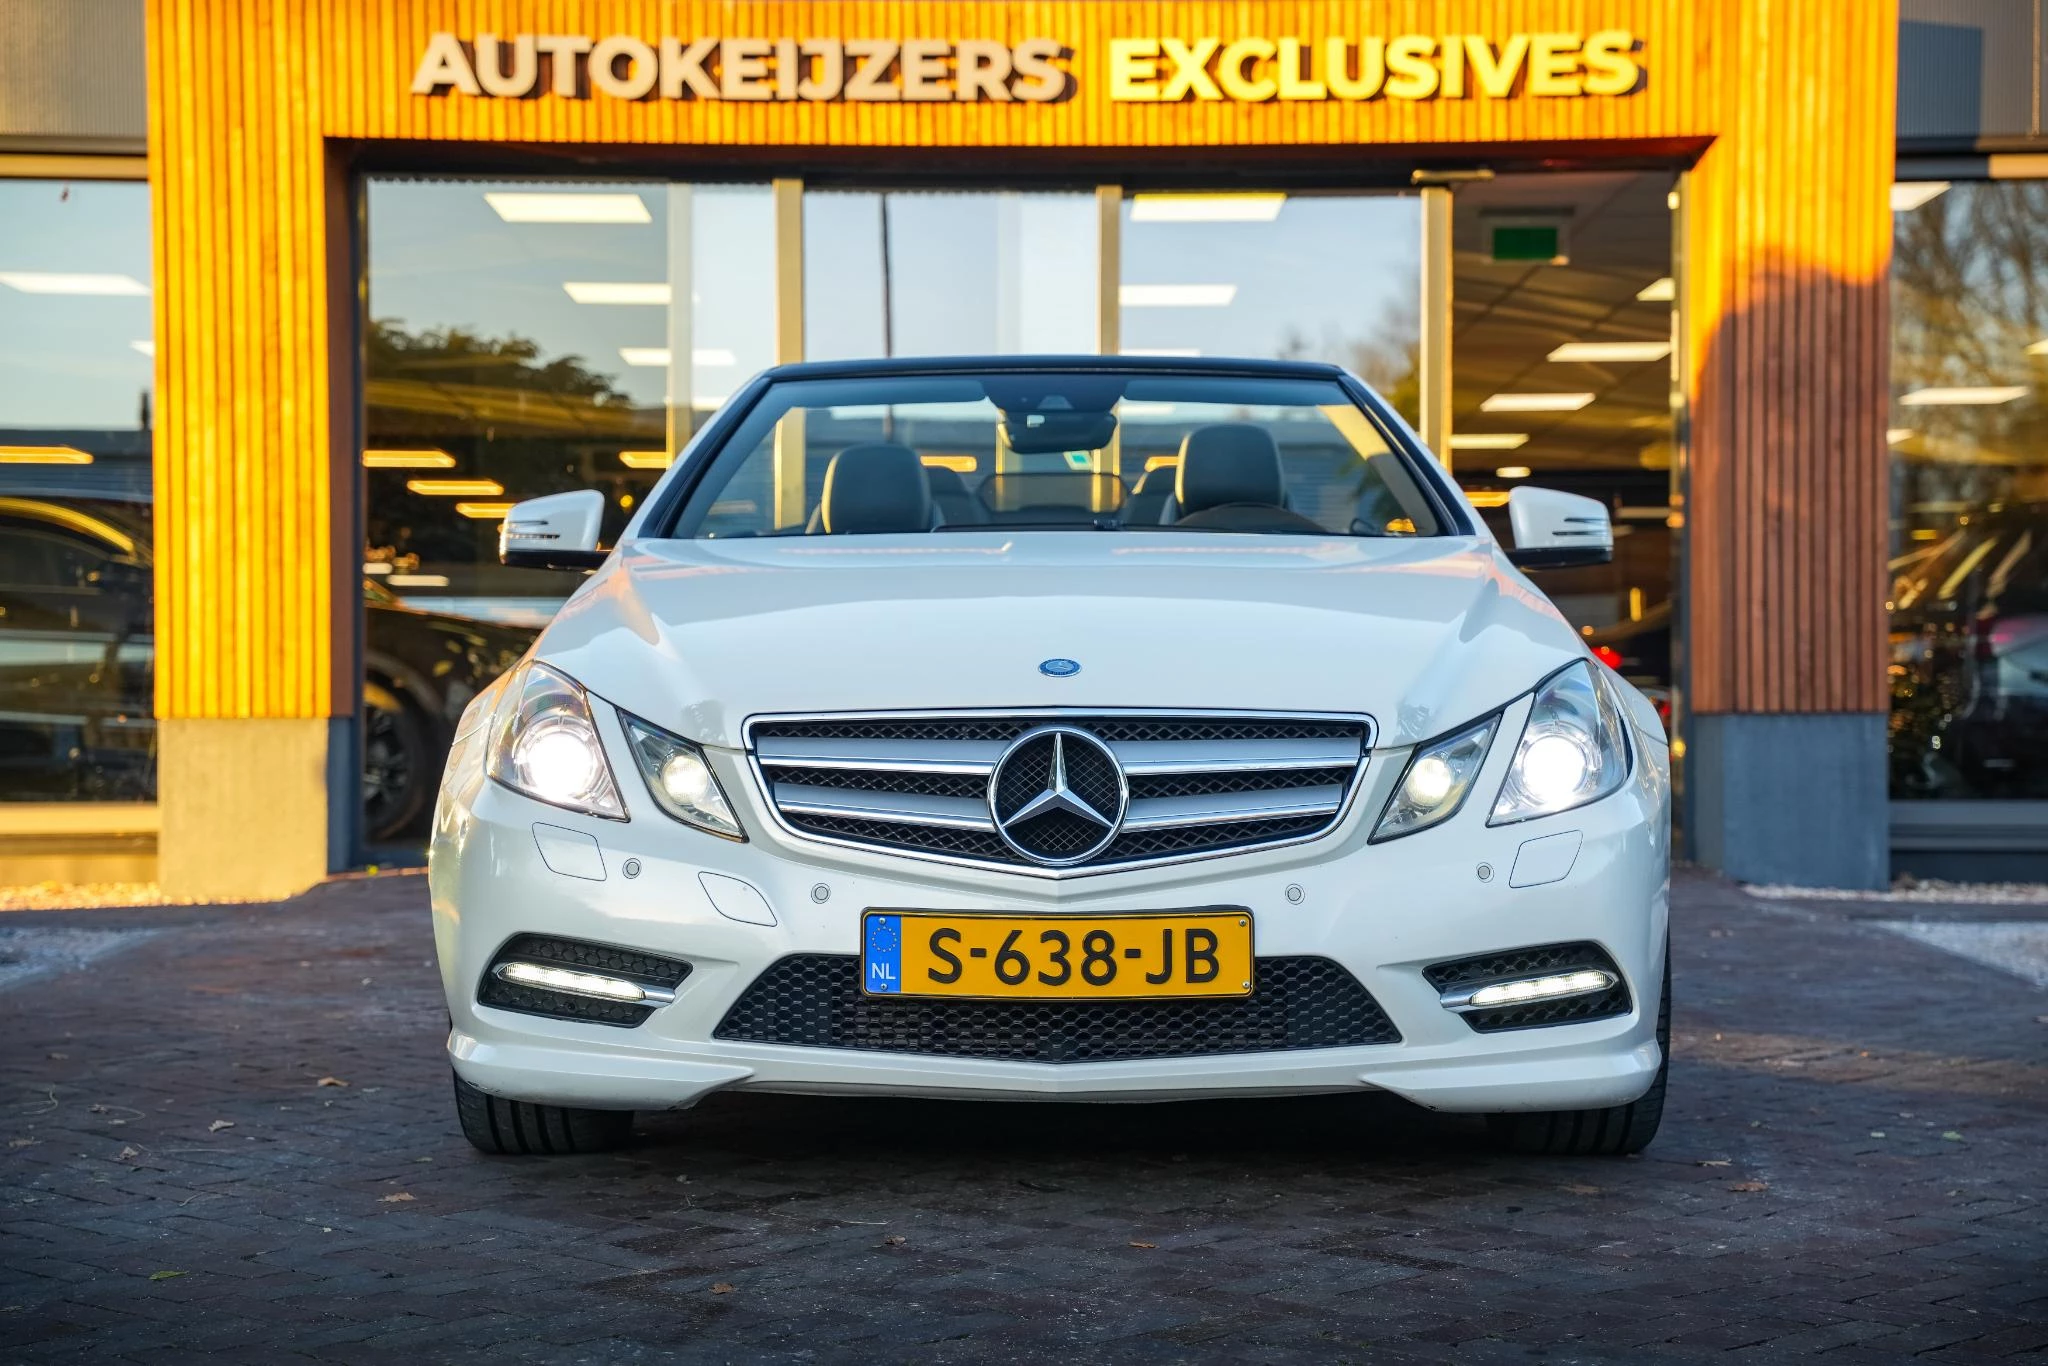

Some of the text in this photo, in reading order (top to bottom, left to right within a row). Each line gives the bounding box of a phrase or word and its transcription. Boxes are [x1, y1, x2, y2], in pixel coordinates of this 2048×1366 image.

[410, 30, 1642, 102] AUTOKEIJZERS EXCLUSIVES
[871, 962, 896, 980] NL
[927, 927, 1220, 986] S-638-JB
